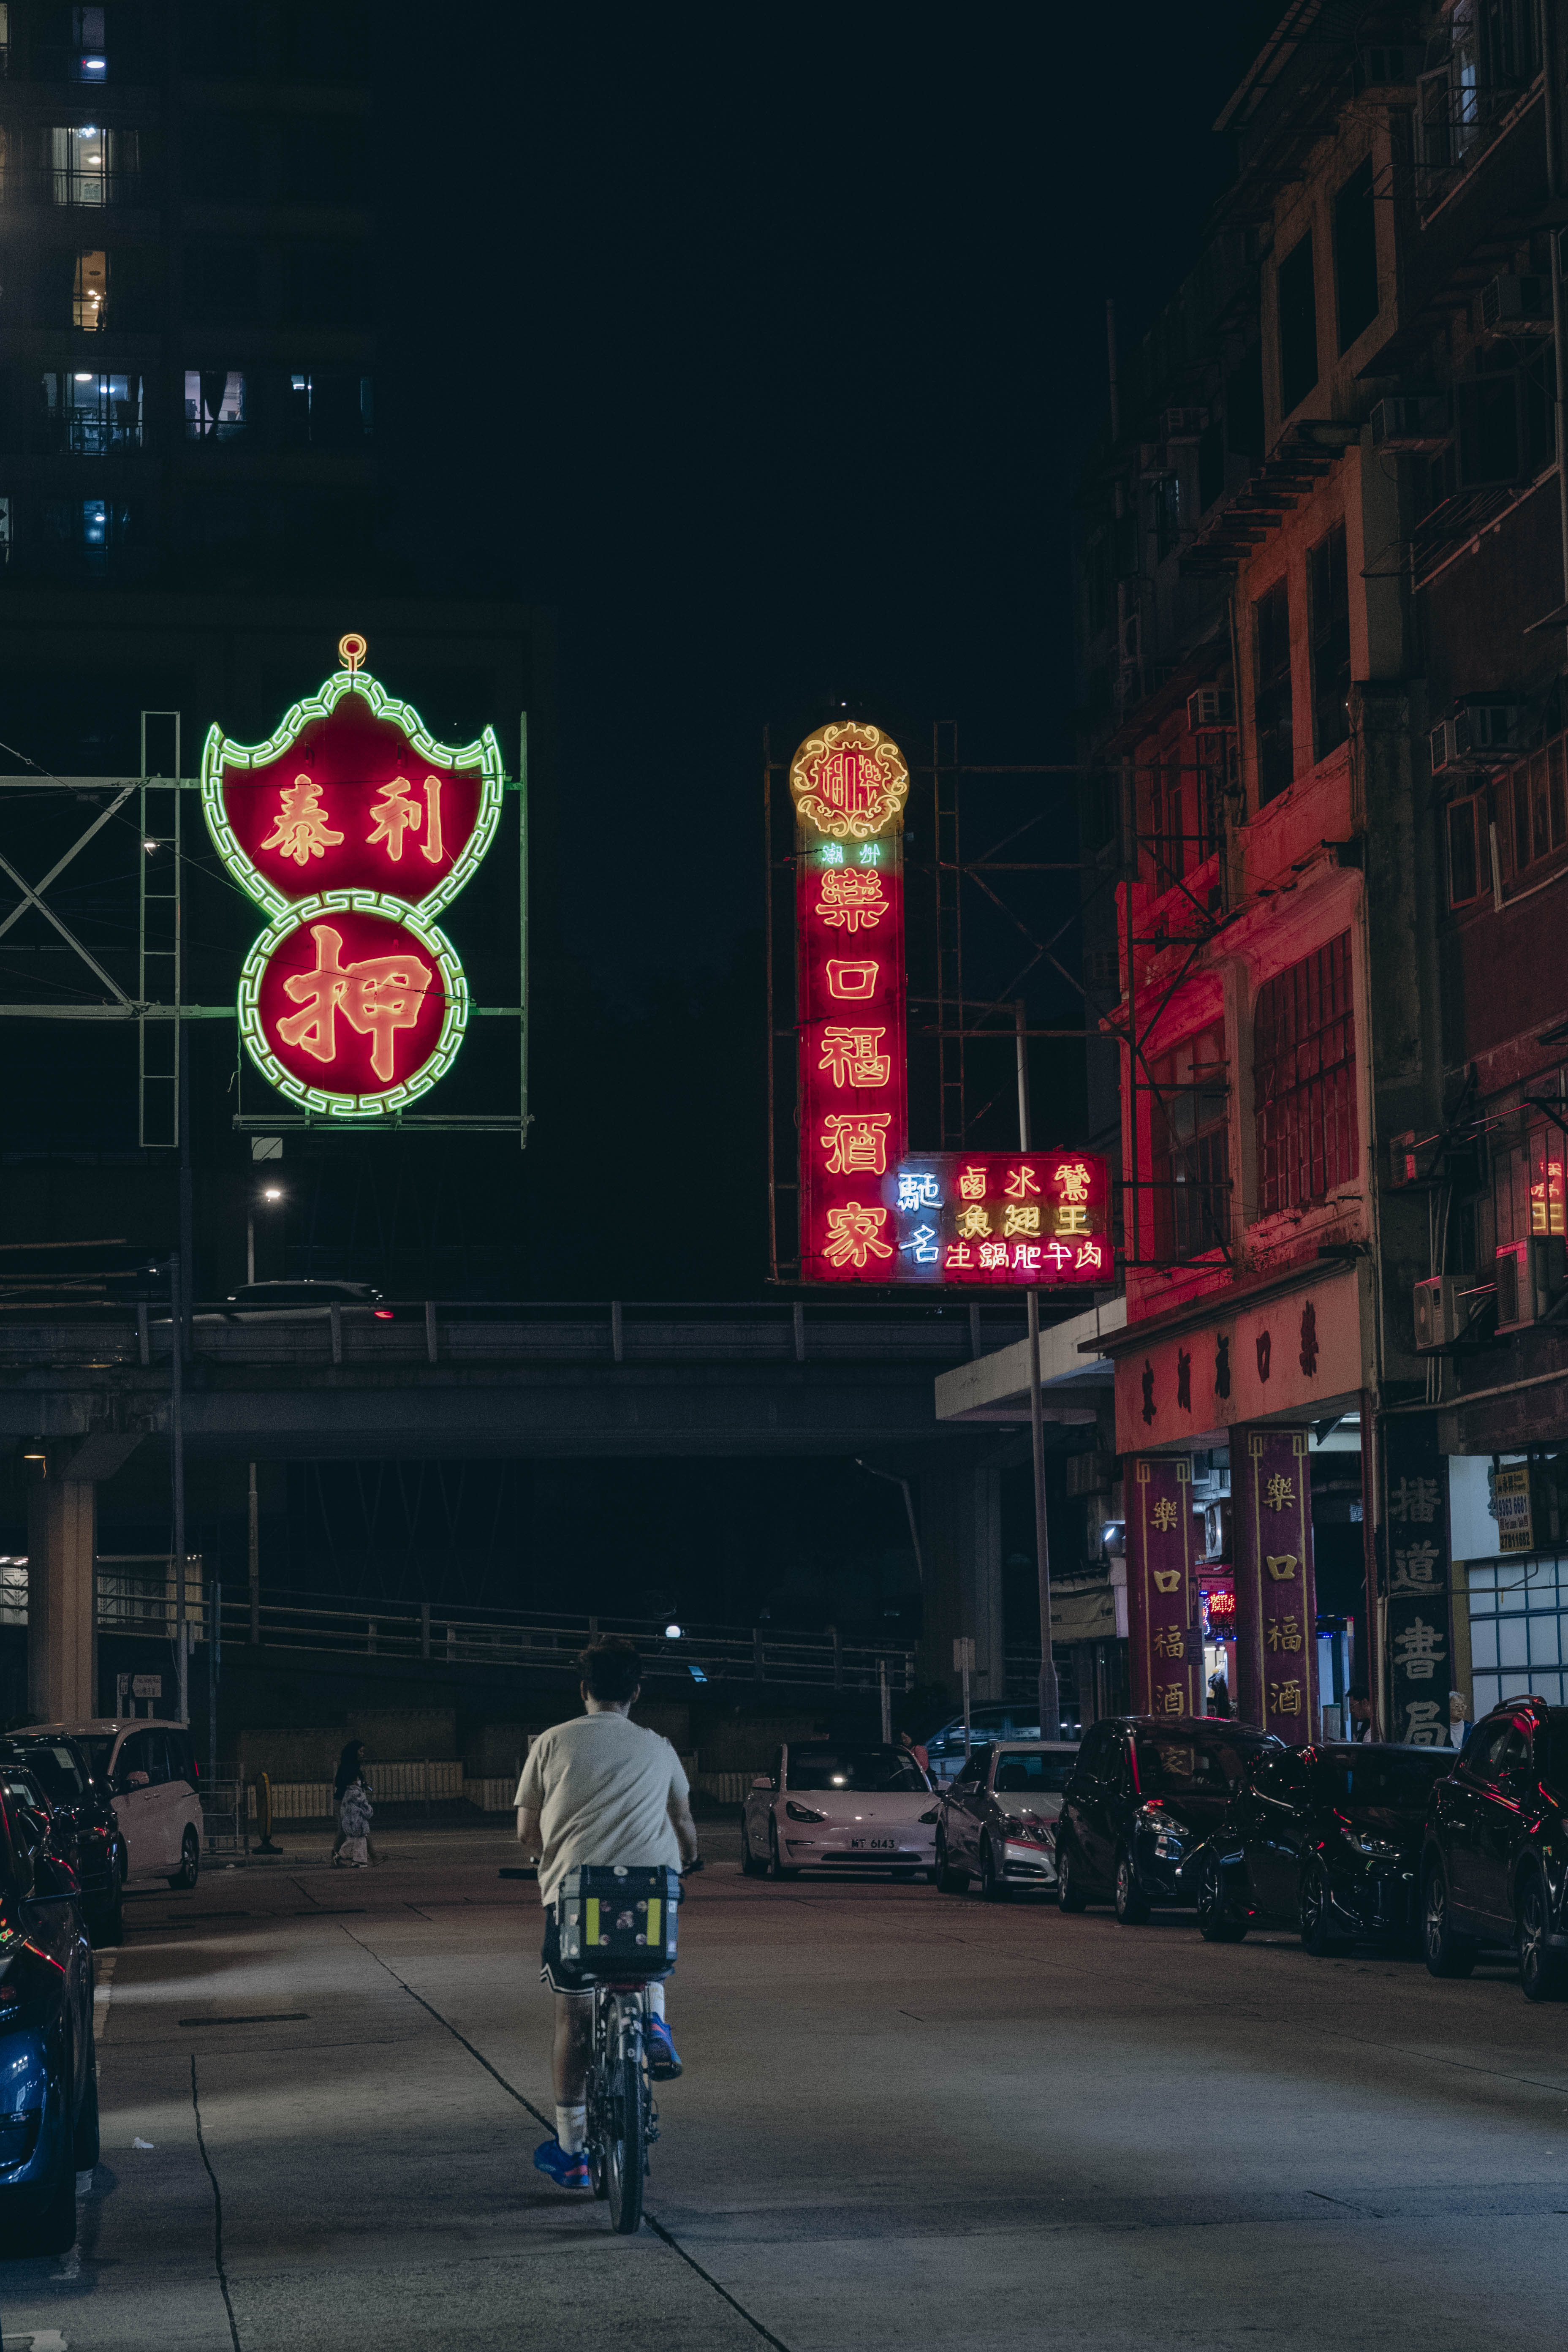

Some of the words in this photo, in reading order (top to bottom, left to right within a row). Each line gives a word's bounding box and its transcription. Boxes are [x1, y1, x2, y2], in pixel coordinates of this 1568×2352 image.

[261, 774, 443, 866] 泰利
[822, 842, 880, 866] 潮州
[276, 925, 432, 1083] 押
[815, 867, 893, 1267] 樂口福酒家
[897, 1172, 945, 1264] 馳名
[955, 1204, 1094, 1238] 魚翅王
[1391, 1476, 1449, 1746] 播道書局
[851, 1839, 866, 1848] MT
[871, 1839, 895, 1849] 6143
